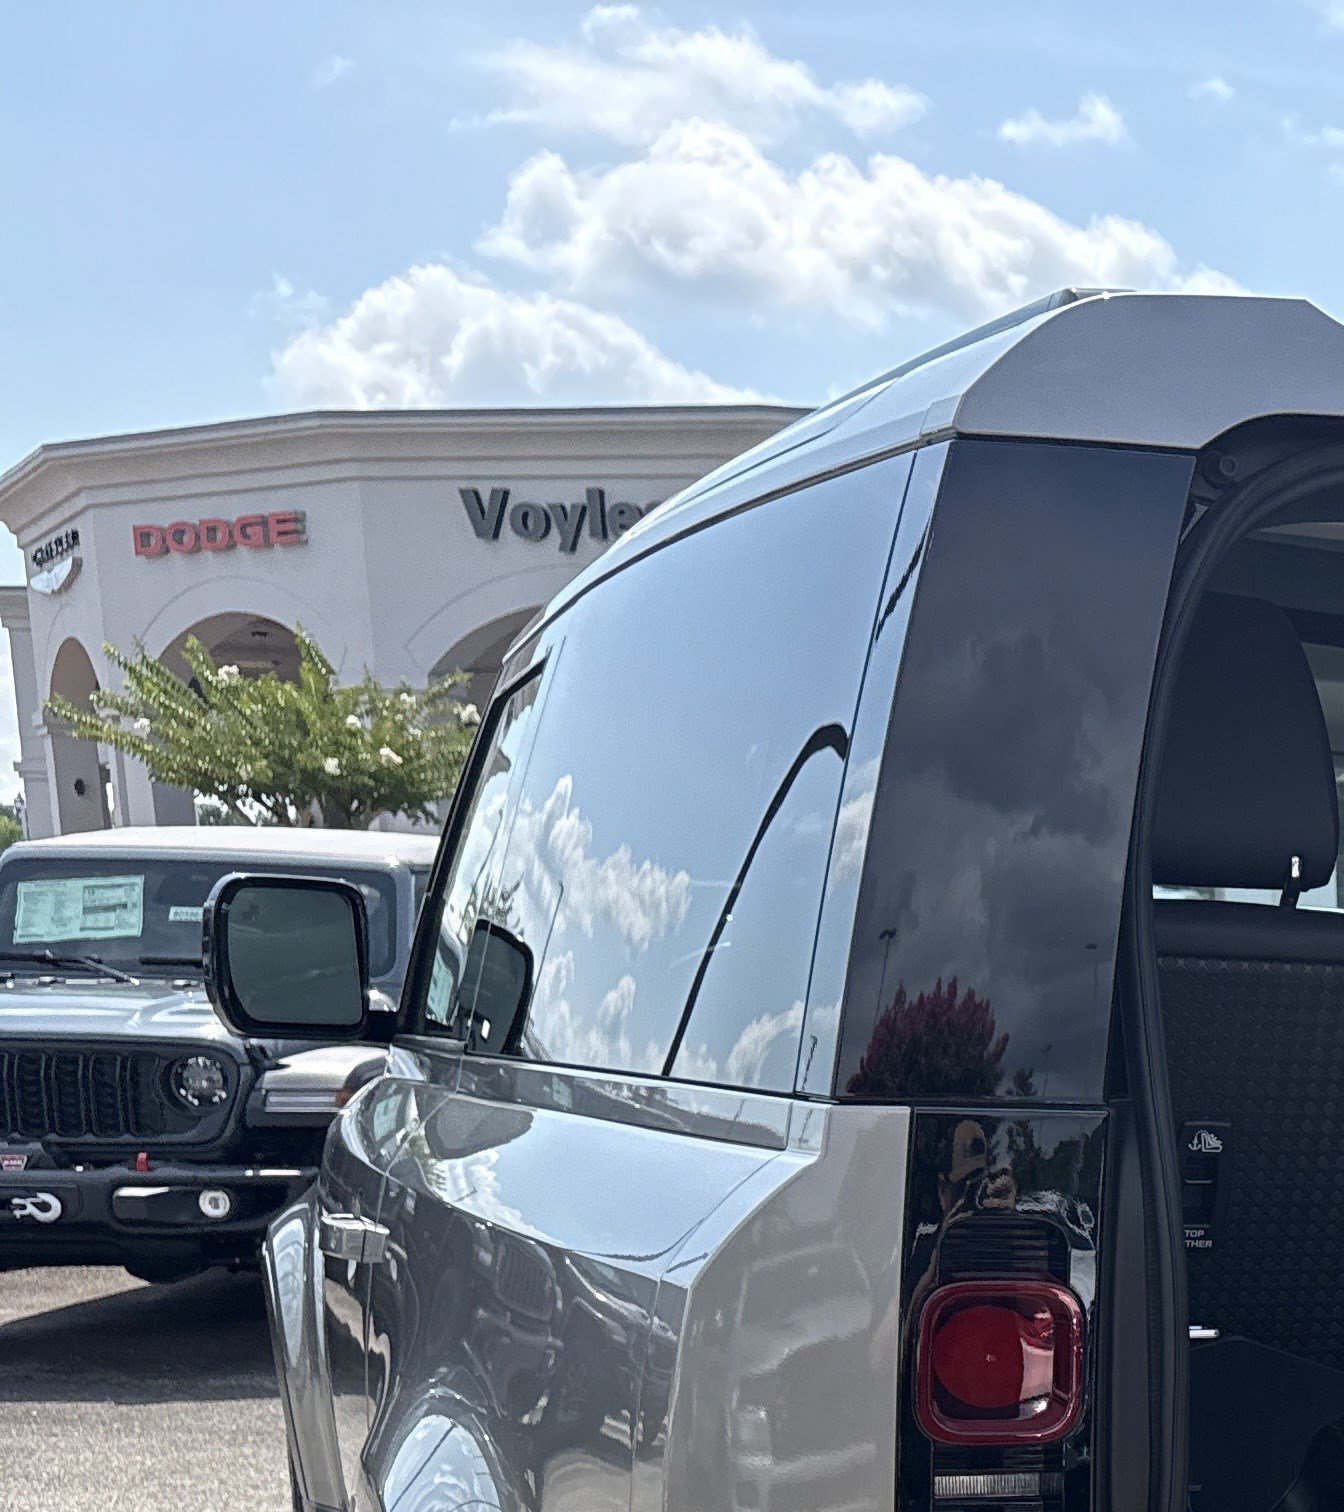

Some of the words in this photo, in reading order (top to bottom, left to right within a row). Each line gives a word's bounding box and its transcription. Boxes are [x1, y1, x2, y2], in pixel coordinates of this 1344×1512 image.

[132, 510, 308, 558] DODGE
[458, 486, 660, 554] Voyle
[1184, 1229, 1205, 1238] TOP
[1185, 1239, 1213, 1248] THER
